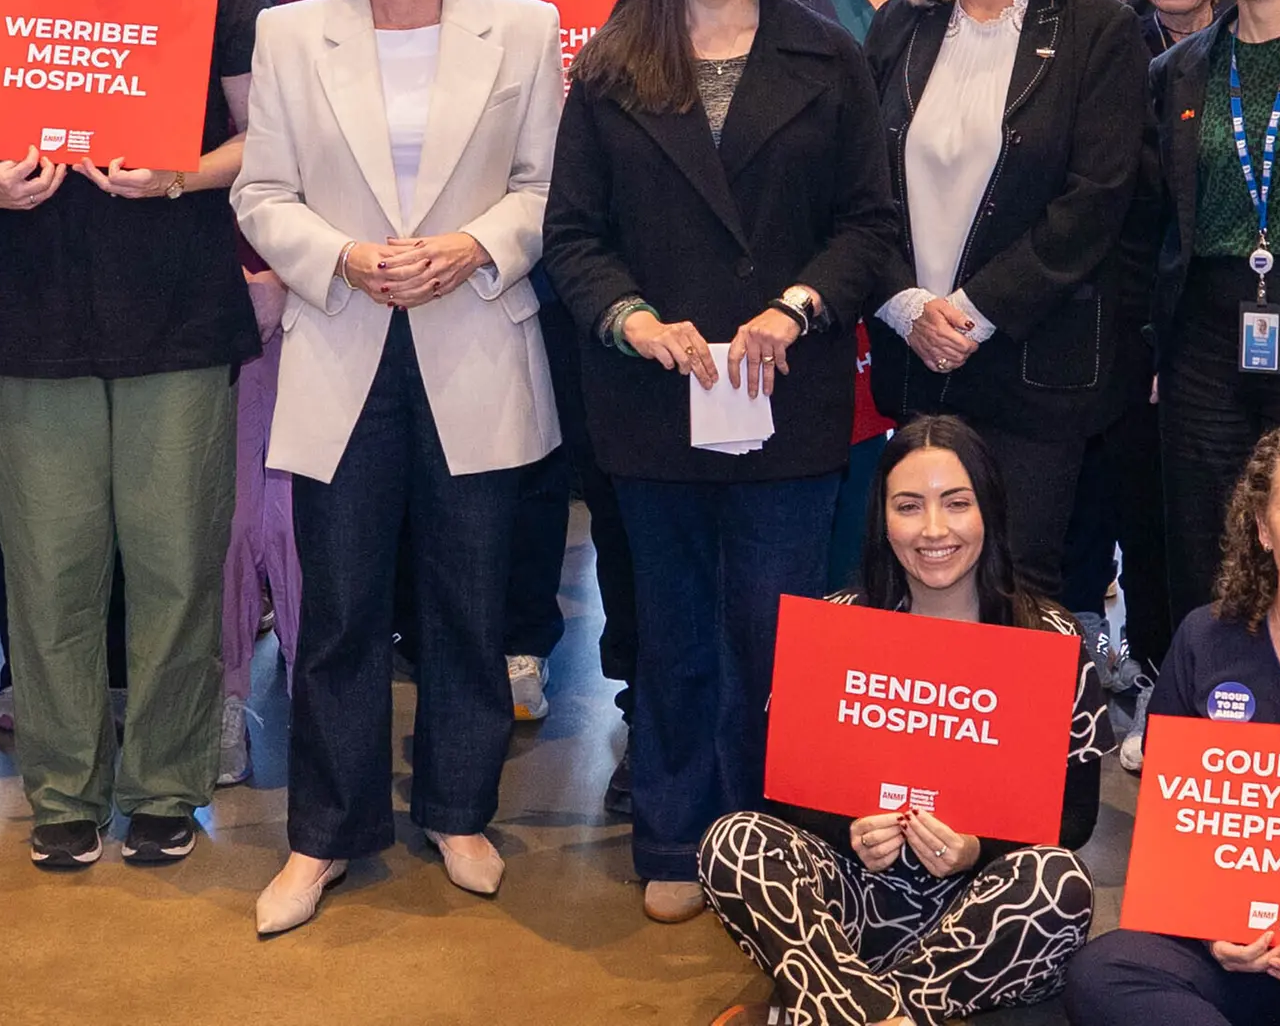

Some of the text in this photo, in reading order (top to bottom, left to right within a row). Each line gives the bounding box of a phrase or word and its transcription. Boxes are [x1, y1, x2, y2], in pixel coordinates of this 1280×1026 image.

[5, 16, 159, 46] WERRIBEE
[27, 42, 131, 69] MERCY
[3, 66, 147, 97] HOSPITAL
[845, 669, 998, 713] BENDIGO
[1214, 691, 1250, 702] PROUD
[838, 699, 999, 745] HOSPITAL
[883, 792, 904, 801] ANMF
[1252, 910, 1276, 920] ANMF
